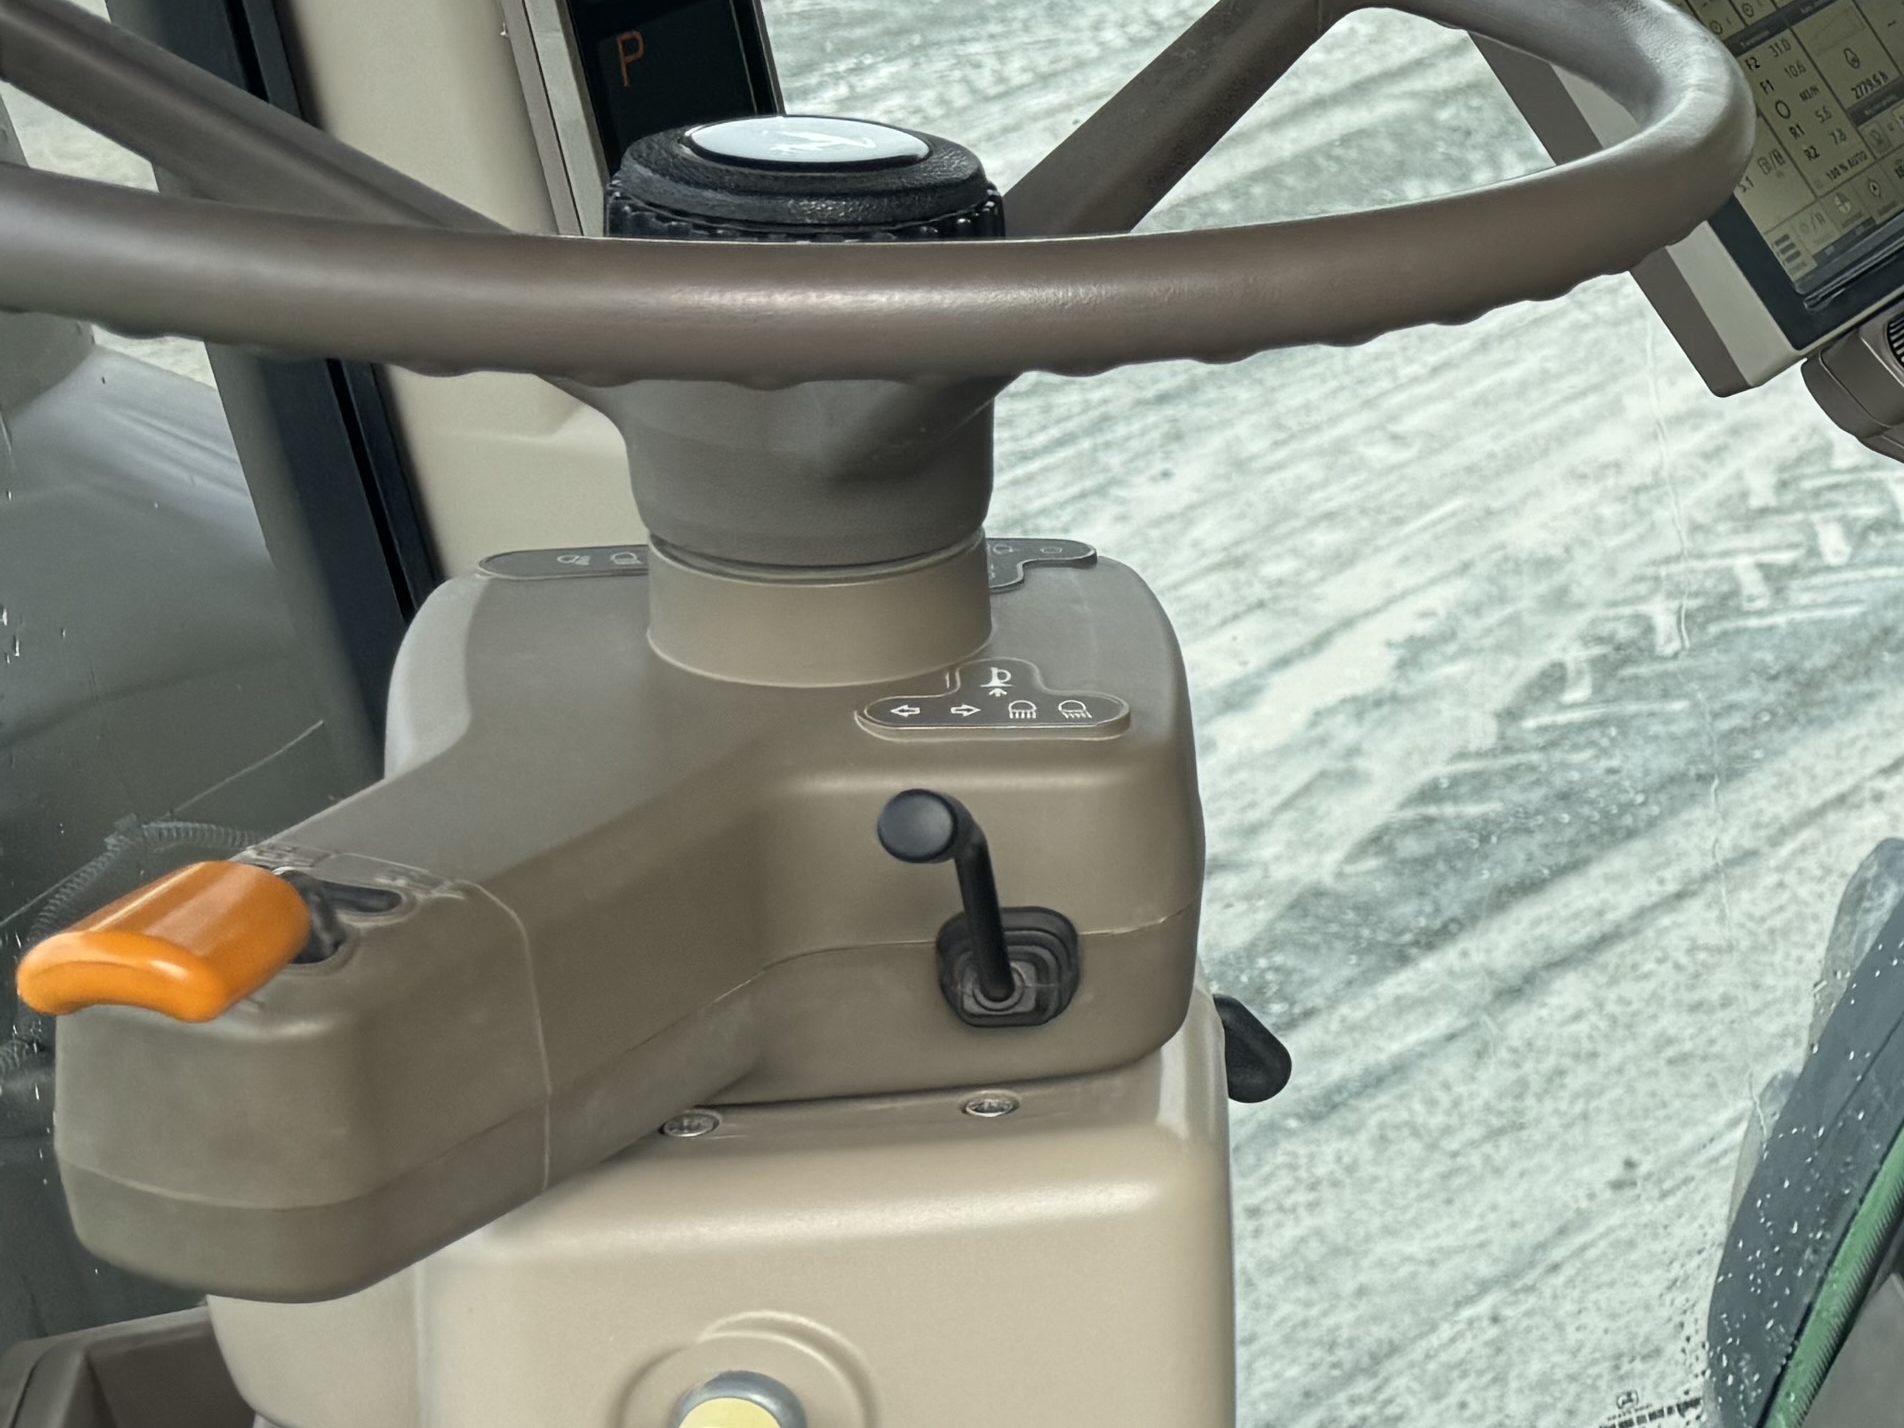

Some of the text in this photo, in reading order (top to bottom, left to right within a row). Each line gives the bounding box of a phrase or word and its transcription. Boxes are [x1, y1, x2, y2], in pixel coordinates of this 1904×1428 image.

[617, 30, 645, 88] P
[1744, 56, 1760, 71] F2
[1759, 79, 1774, 94] F1
[1789, 123, 1804, 138] R1
[1803, 144, 1819, 160] R2
